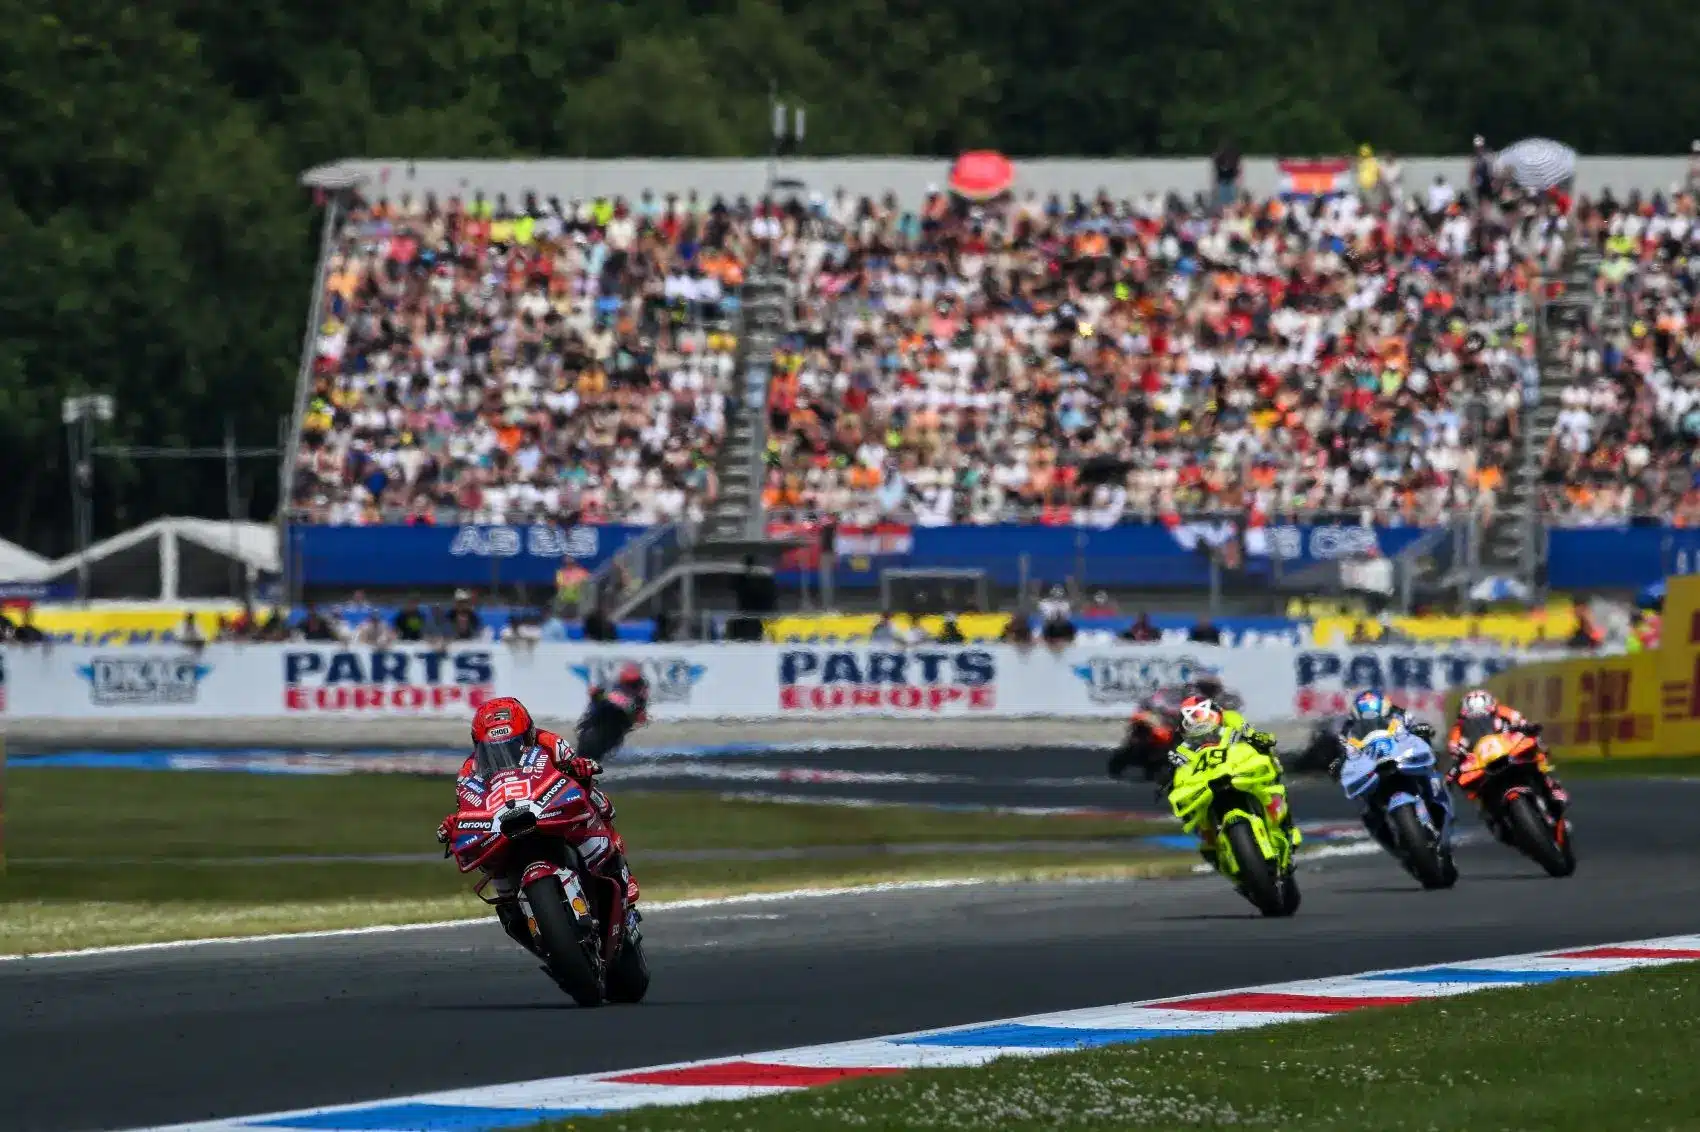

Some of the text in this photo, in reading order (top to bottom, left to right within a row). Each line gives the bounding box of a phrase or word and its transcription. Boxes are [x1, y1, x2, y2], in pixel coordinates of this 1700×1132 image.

[284, 651, 493, 684] PARTS
[779, 651, 995, 685] PARTS
[284, 686, 494, 710] EUROPE
[779, 686, 996, 711] EUROPE
[490, 727, 509, 737] SHOEI
[1192, 748, 1228, 775] 49
[538, 778, 567, 806] Lenovo
[457, 821, 492, 829] Lenovo
